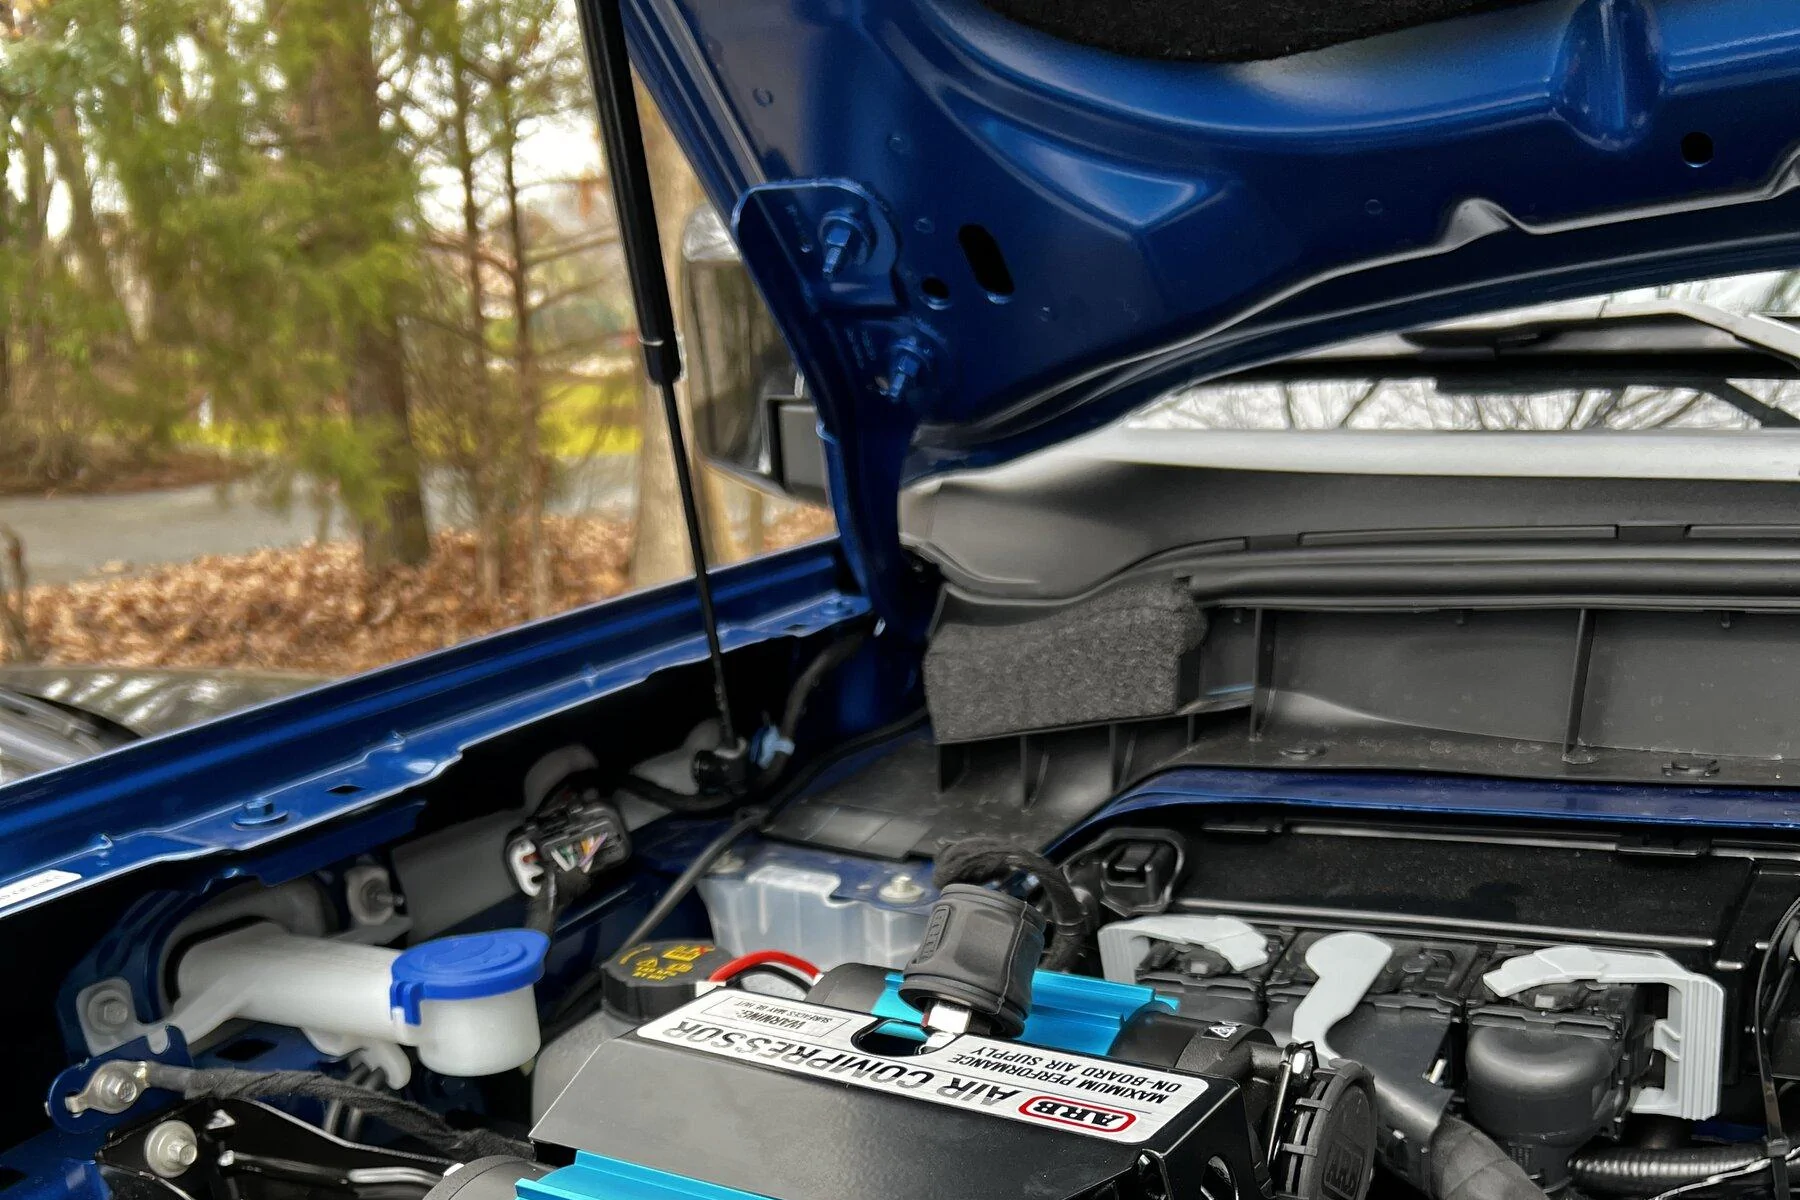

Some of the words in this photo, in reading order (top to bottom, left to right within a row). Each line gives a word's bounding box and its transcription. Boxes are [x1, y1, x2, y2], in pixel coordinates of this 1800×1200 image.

[662, 1020, 934, 1088] COMPRESSOR
[972, 1046, 1043, 1066] SUPPLY
[1045, 1059, 1082, 1073] AIR
[947, 1053, 1075, 1086] PERFORMANCE
[1081, 1067, 1183, 1093] ON-BOARD
[937, 1077, 1022, 1105] AIR
[1076, 1079, 1170, 1104] MAXIMUM
[1033, 1101, 1124, 1126] ARB
